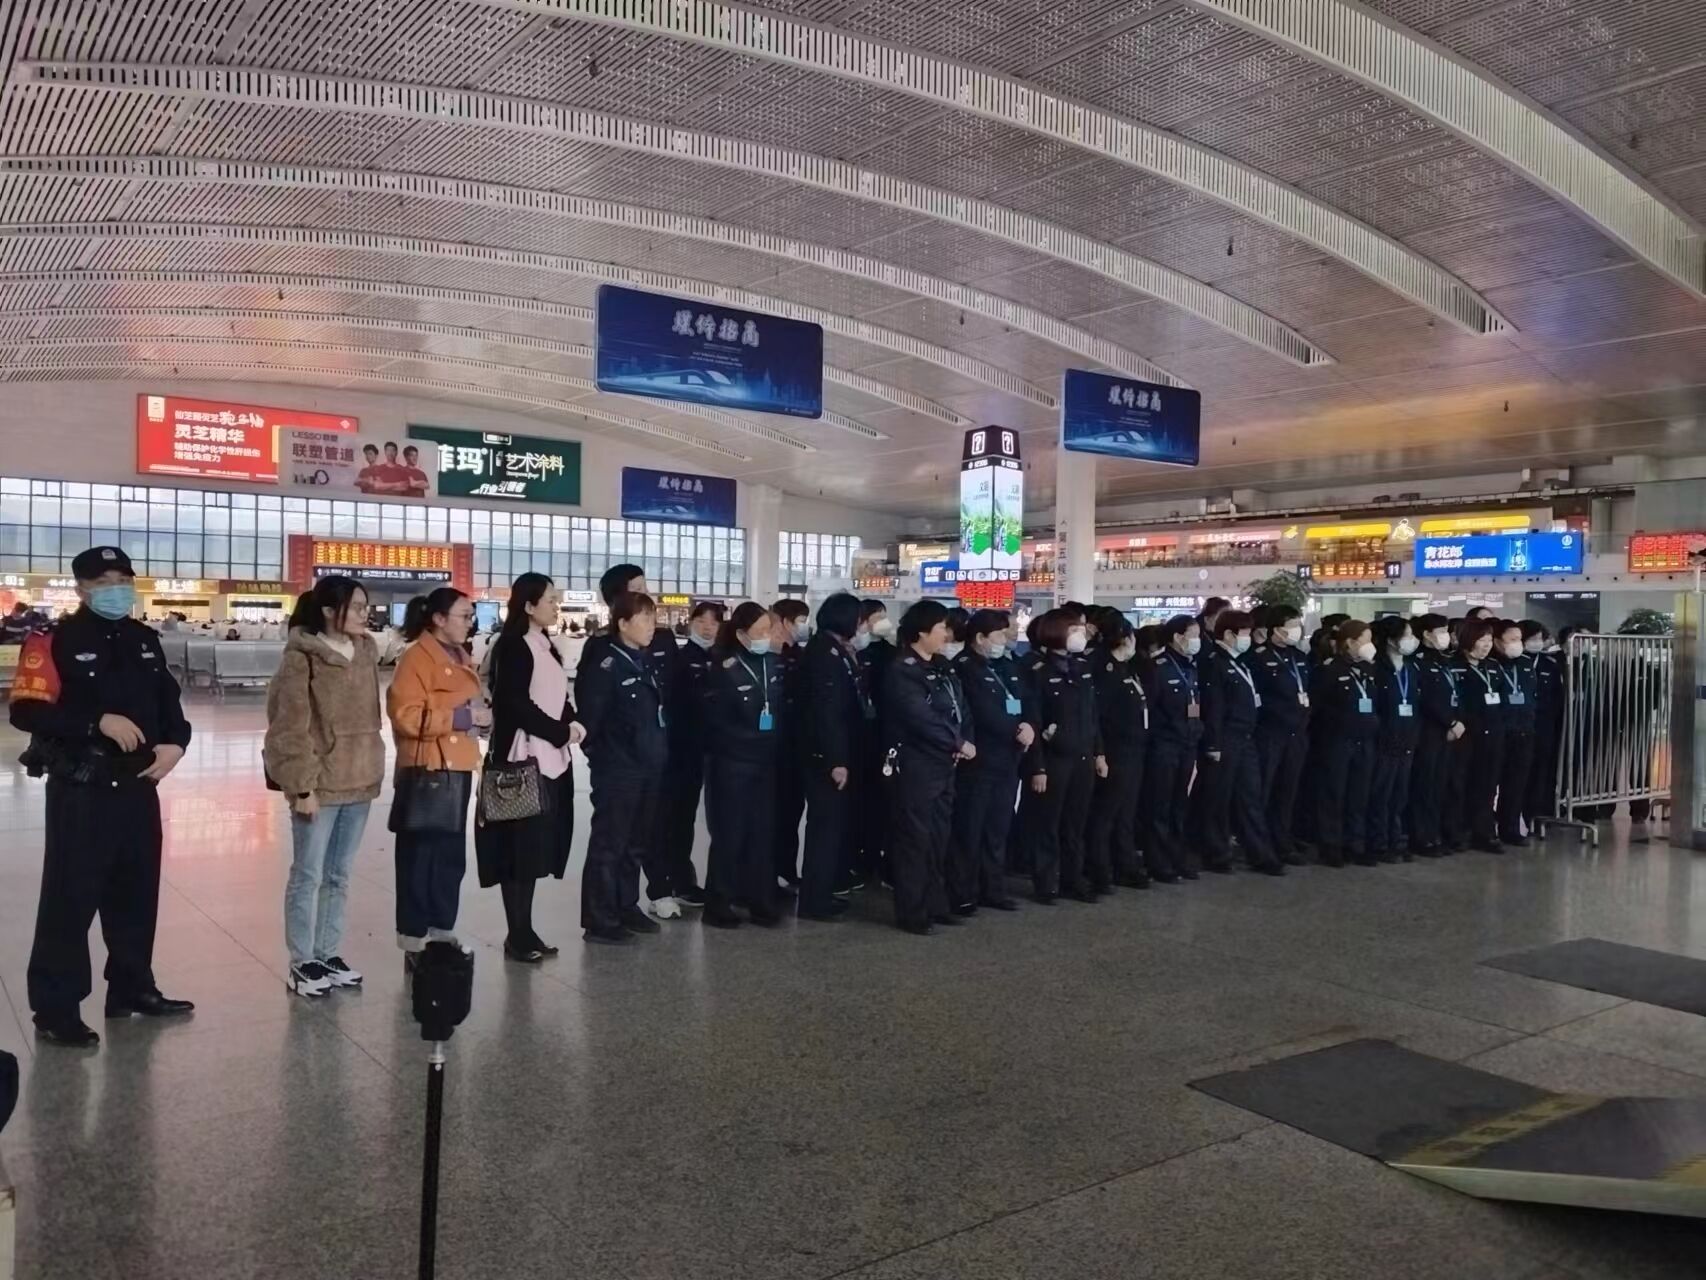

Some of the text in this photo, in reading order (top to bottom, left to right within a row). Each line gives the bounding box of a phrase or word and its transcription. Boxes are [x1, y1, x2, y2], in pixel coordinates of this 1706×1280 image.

[175, 423, 245, 443] 灵芝精华
[292, 442, 354, 462] 联塑管道
[505, 451, 565, 482] 艺术涂料
